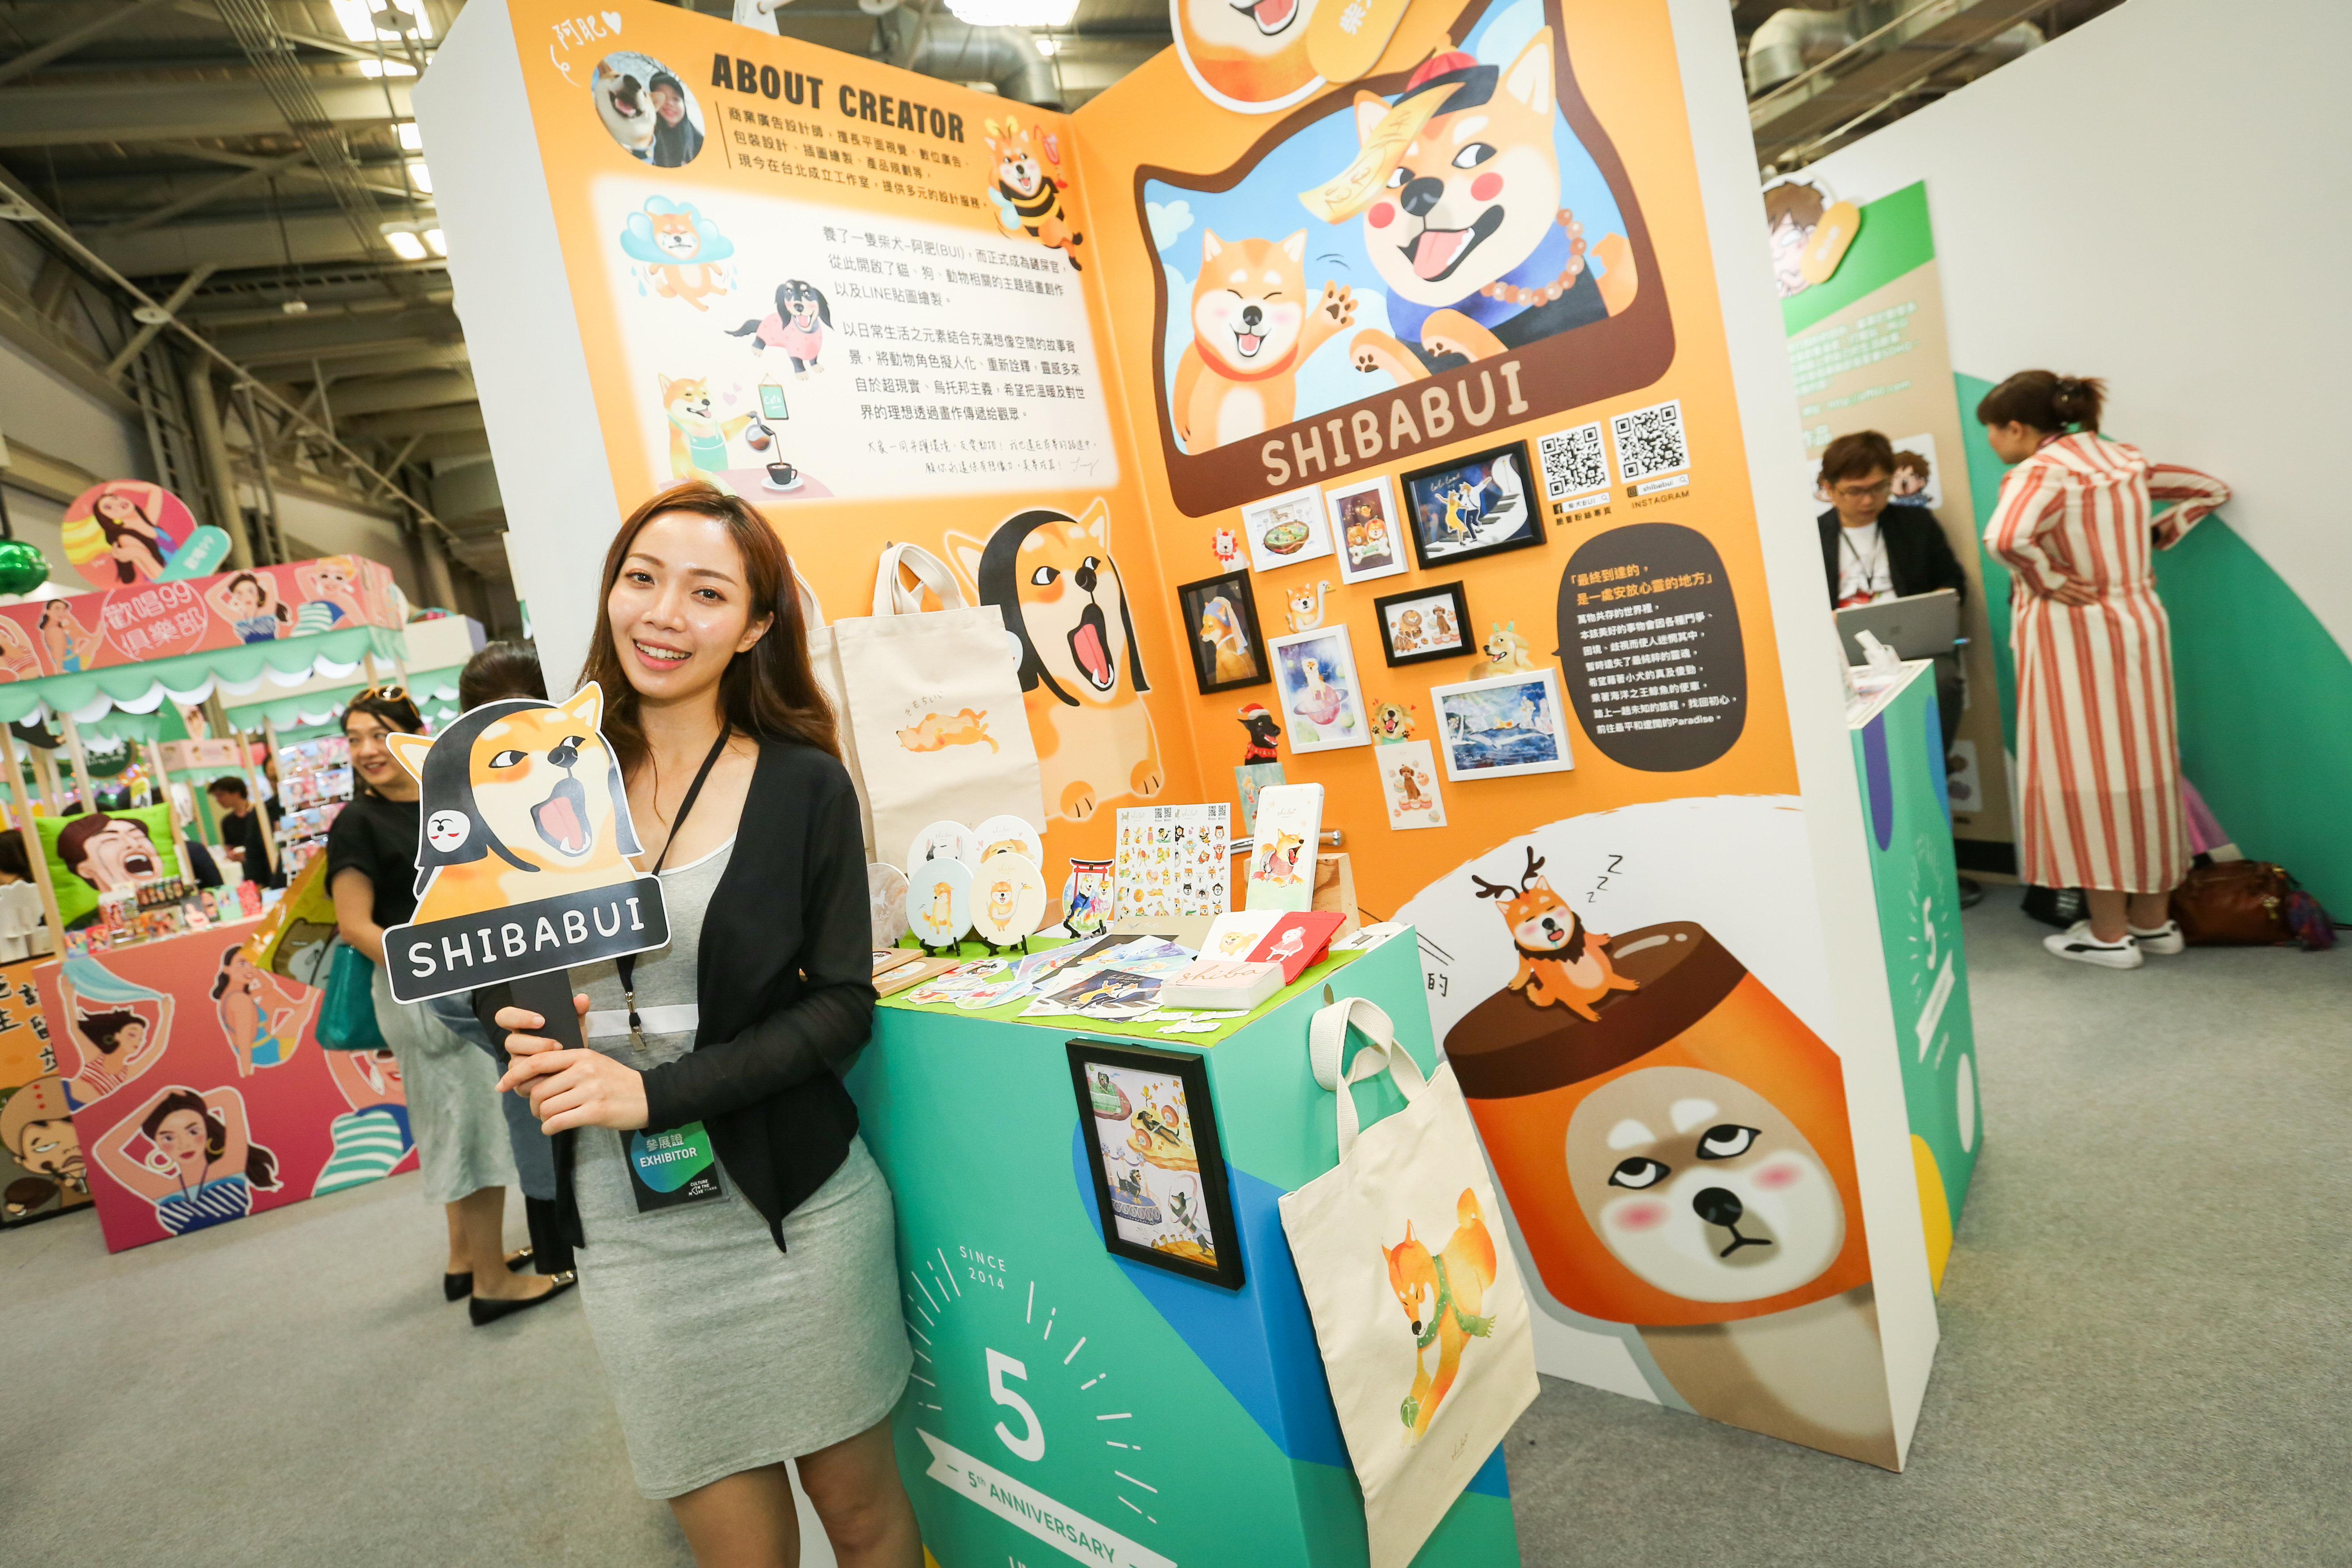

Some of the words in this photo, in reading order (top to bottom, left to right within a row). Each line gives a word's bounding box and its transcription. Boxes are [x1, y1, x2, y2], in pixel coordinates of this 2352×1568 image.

[1339, 0, 1371, 35] 柴
[552, 15, 607, 51] 阿肥
[711, 53, 823, 109] ABOUT
[839, 84, 965, 143] CREATOR
[835, 281, 951, 307] 以及LINE貼圖繪製。
[843, 322, 1076, 353] 以日常生活之元素結合充滿想像空間的故事背
[860, 404, 1028, 421] 界的理想透過畫作傳遞給觀眾。
[1261, 360, 1529, 486] SHIBABUI
[1632, 490, 1690, 508] INSTAGRAM
[1643, 480, 1674, 492] shibabui
[1568, 498, 1596, 509] 柴犬BUI
[408, 897, 645, 978] SHIBABUI
[1176, 963, 1264, 984] shiba
[1428, 973, 1448, 997] 的
[646, 1133, 684, 1152] 參展證
[639, 1147, 698, 1167] EXHIBITOR
[959, 1245, 1006, 1272] SINCE
[969, 1267, 1005, 1290] 2014
[985, 1347, 1045, 1462] 5
[968, 1471, 985, 1488] 5th
[990, 1483, 1114, 1563] ANNIVERSARY
